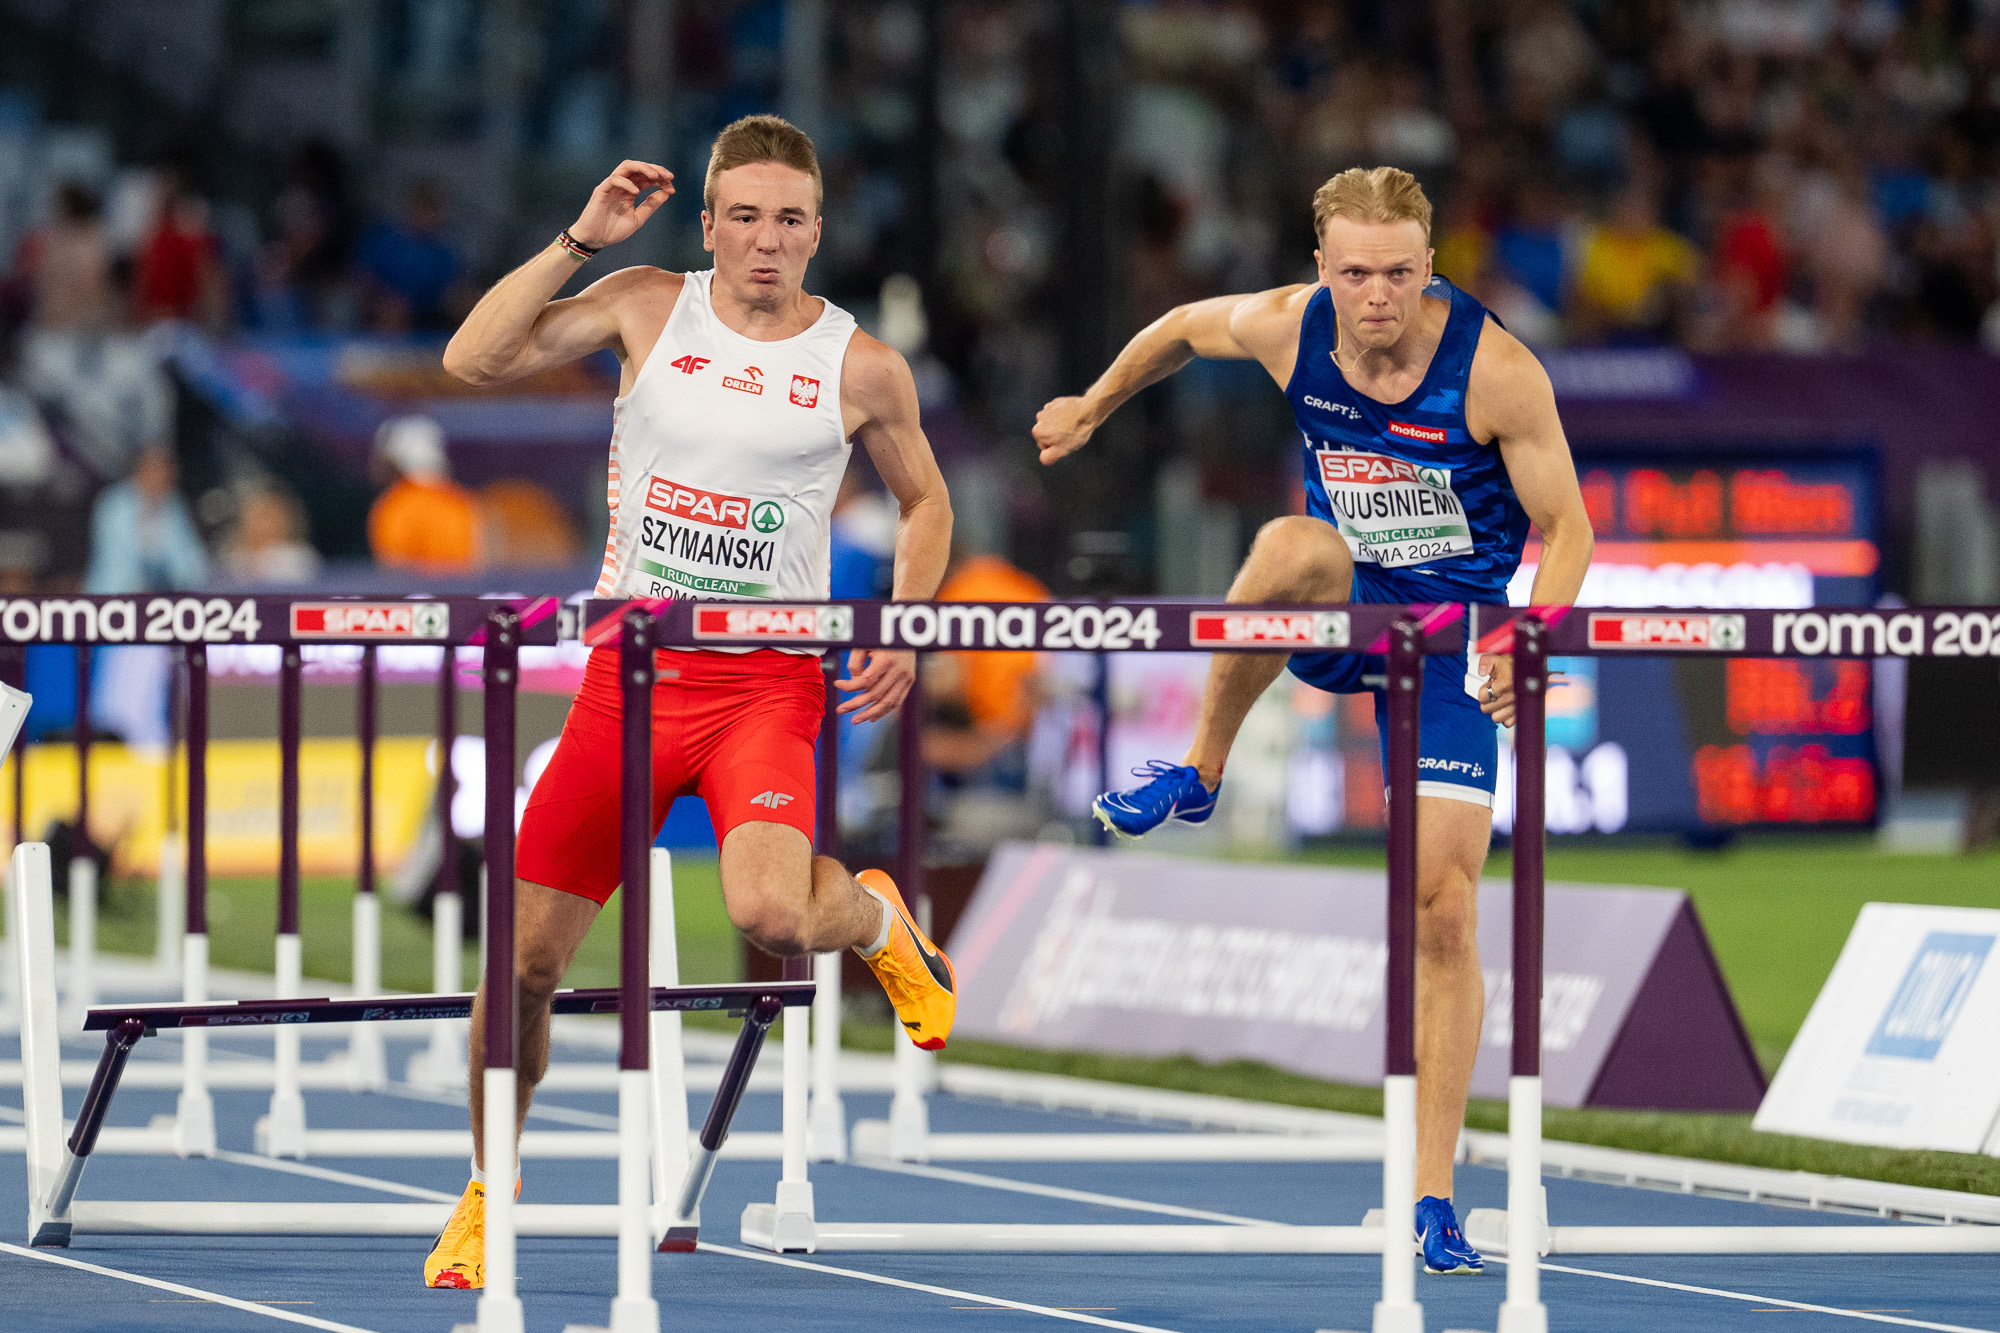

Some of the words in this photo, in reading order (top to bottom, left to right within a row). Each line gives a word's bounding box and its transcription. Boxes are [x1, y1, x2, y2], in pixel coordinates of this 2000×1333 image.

[671, 355, 711, 374] 4F
[724, 378, 761, 394] ORLEN
[1304, 395, 1349, 415] CRAFT
[1391, 423, 1444, 442] motonet
[1324, 457, 1416, 481] SPAR
[649, 480, 746, 525] SPAR
[641, 515, 775, 572] SZYMAŃSKI
[1358, 543, 1404, 563] RMA
[1408, 541, 1453, 560] 2024
[661, 567, 667, 577] I
[667, 569, 694, 586] RUN
[0, 599, 137, 642] oma
[145, 598, 262, 642] 2024
[322, 608, 412, 633] SPAR
[726, 609, 815, 635] SPAR
[880, 604, 1036, 649] roma
[1043, 605, 1161, 650] 2024
[1223, 616, 1313, 642] SPAR
[1621, 618, 1709, 644] SPAR
[1772, 613, 1925, 656] roma
[1417, 757, 1473, 774] CRAFT
[750, 790, 795, 809] 4F
[207, 1014, 279, 1026] SPAR
